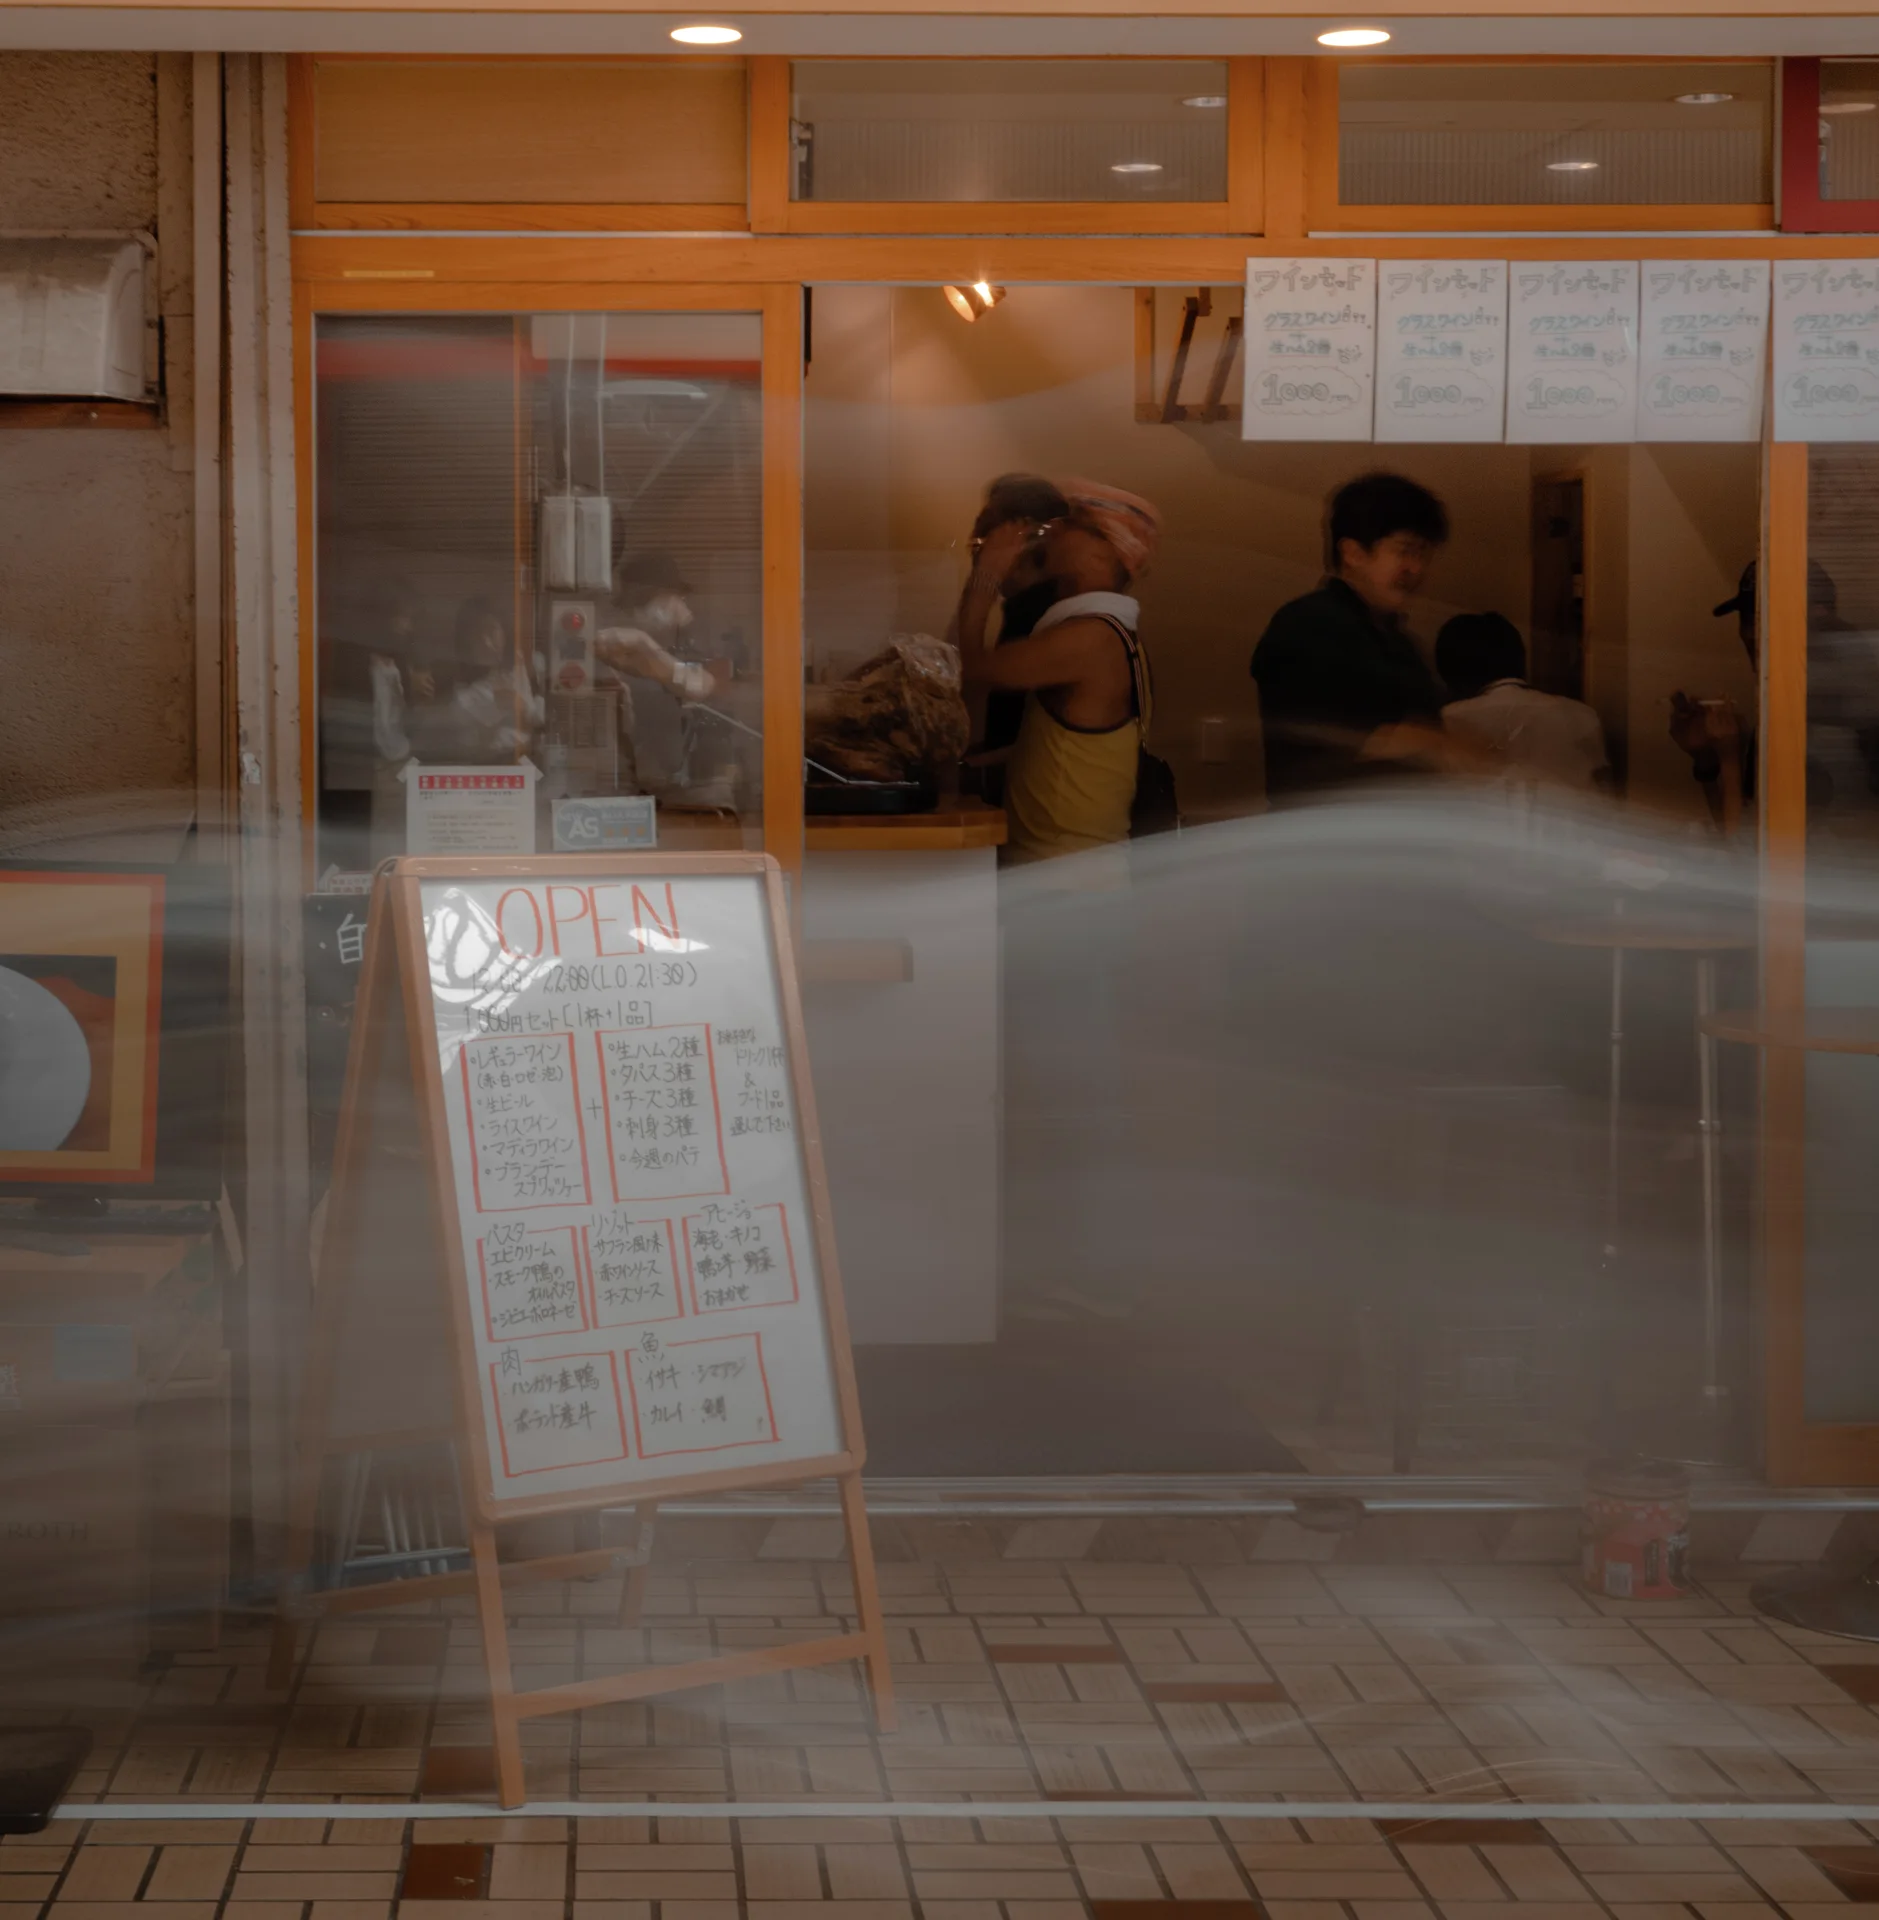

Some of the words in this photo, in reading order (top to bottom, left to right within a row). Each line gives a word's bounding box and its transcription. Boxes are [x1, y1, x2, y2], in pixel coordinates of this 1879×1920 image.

[1261, 373, 1330, 406] 1000
[1394, 376, 1462, 408] 1000
[496, 882, 682, 959] OPEN
[616, 1036, 705, 1061] 生ハム2種
[619, 1061, 697, 1086] タパス3種
[621, 1086, 699, 1111] チーズ3種
[625, 1113, 699, 1140] 刺身3種
[487, 1222, 525, 1246] パスタ
[591, 1209, 635, 1237] リゾット
[490, 1241, 556, 1266] エビクリーム
[637, 1331, 666, 1363] 魚
[501, 1345, 522, 1377] 肉
